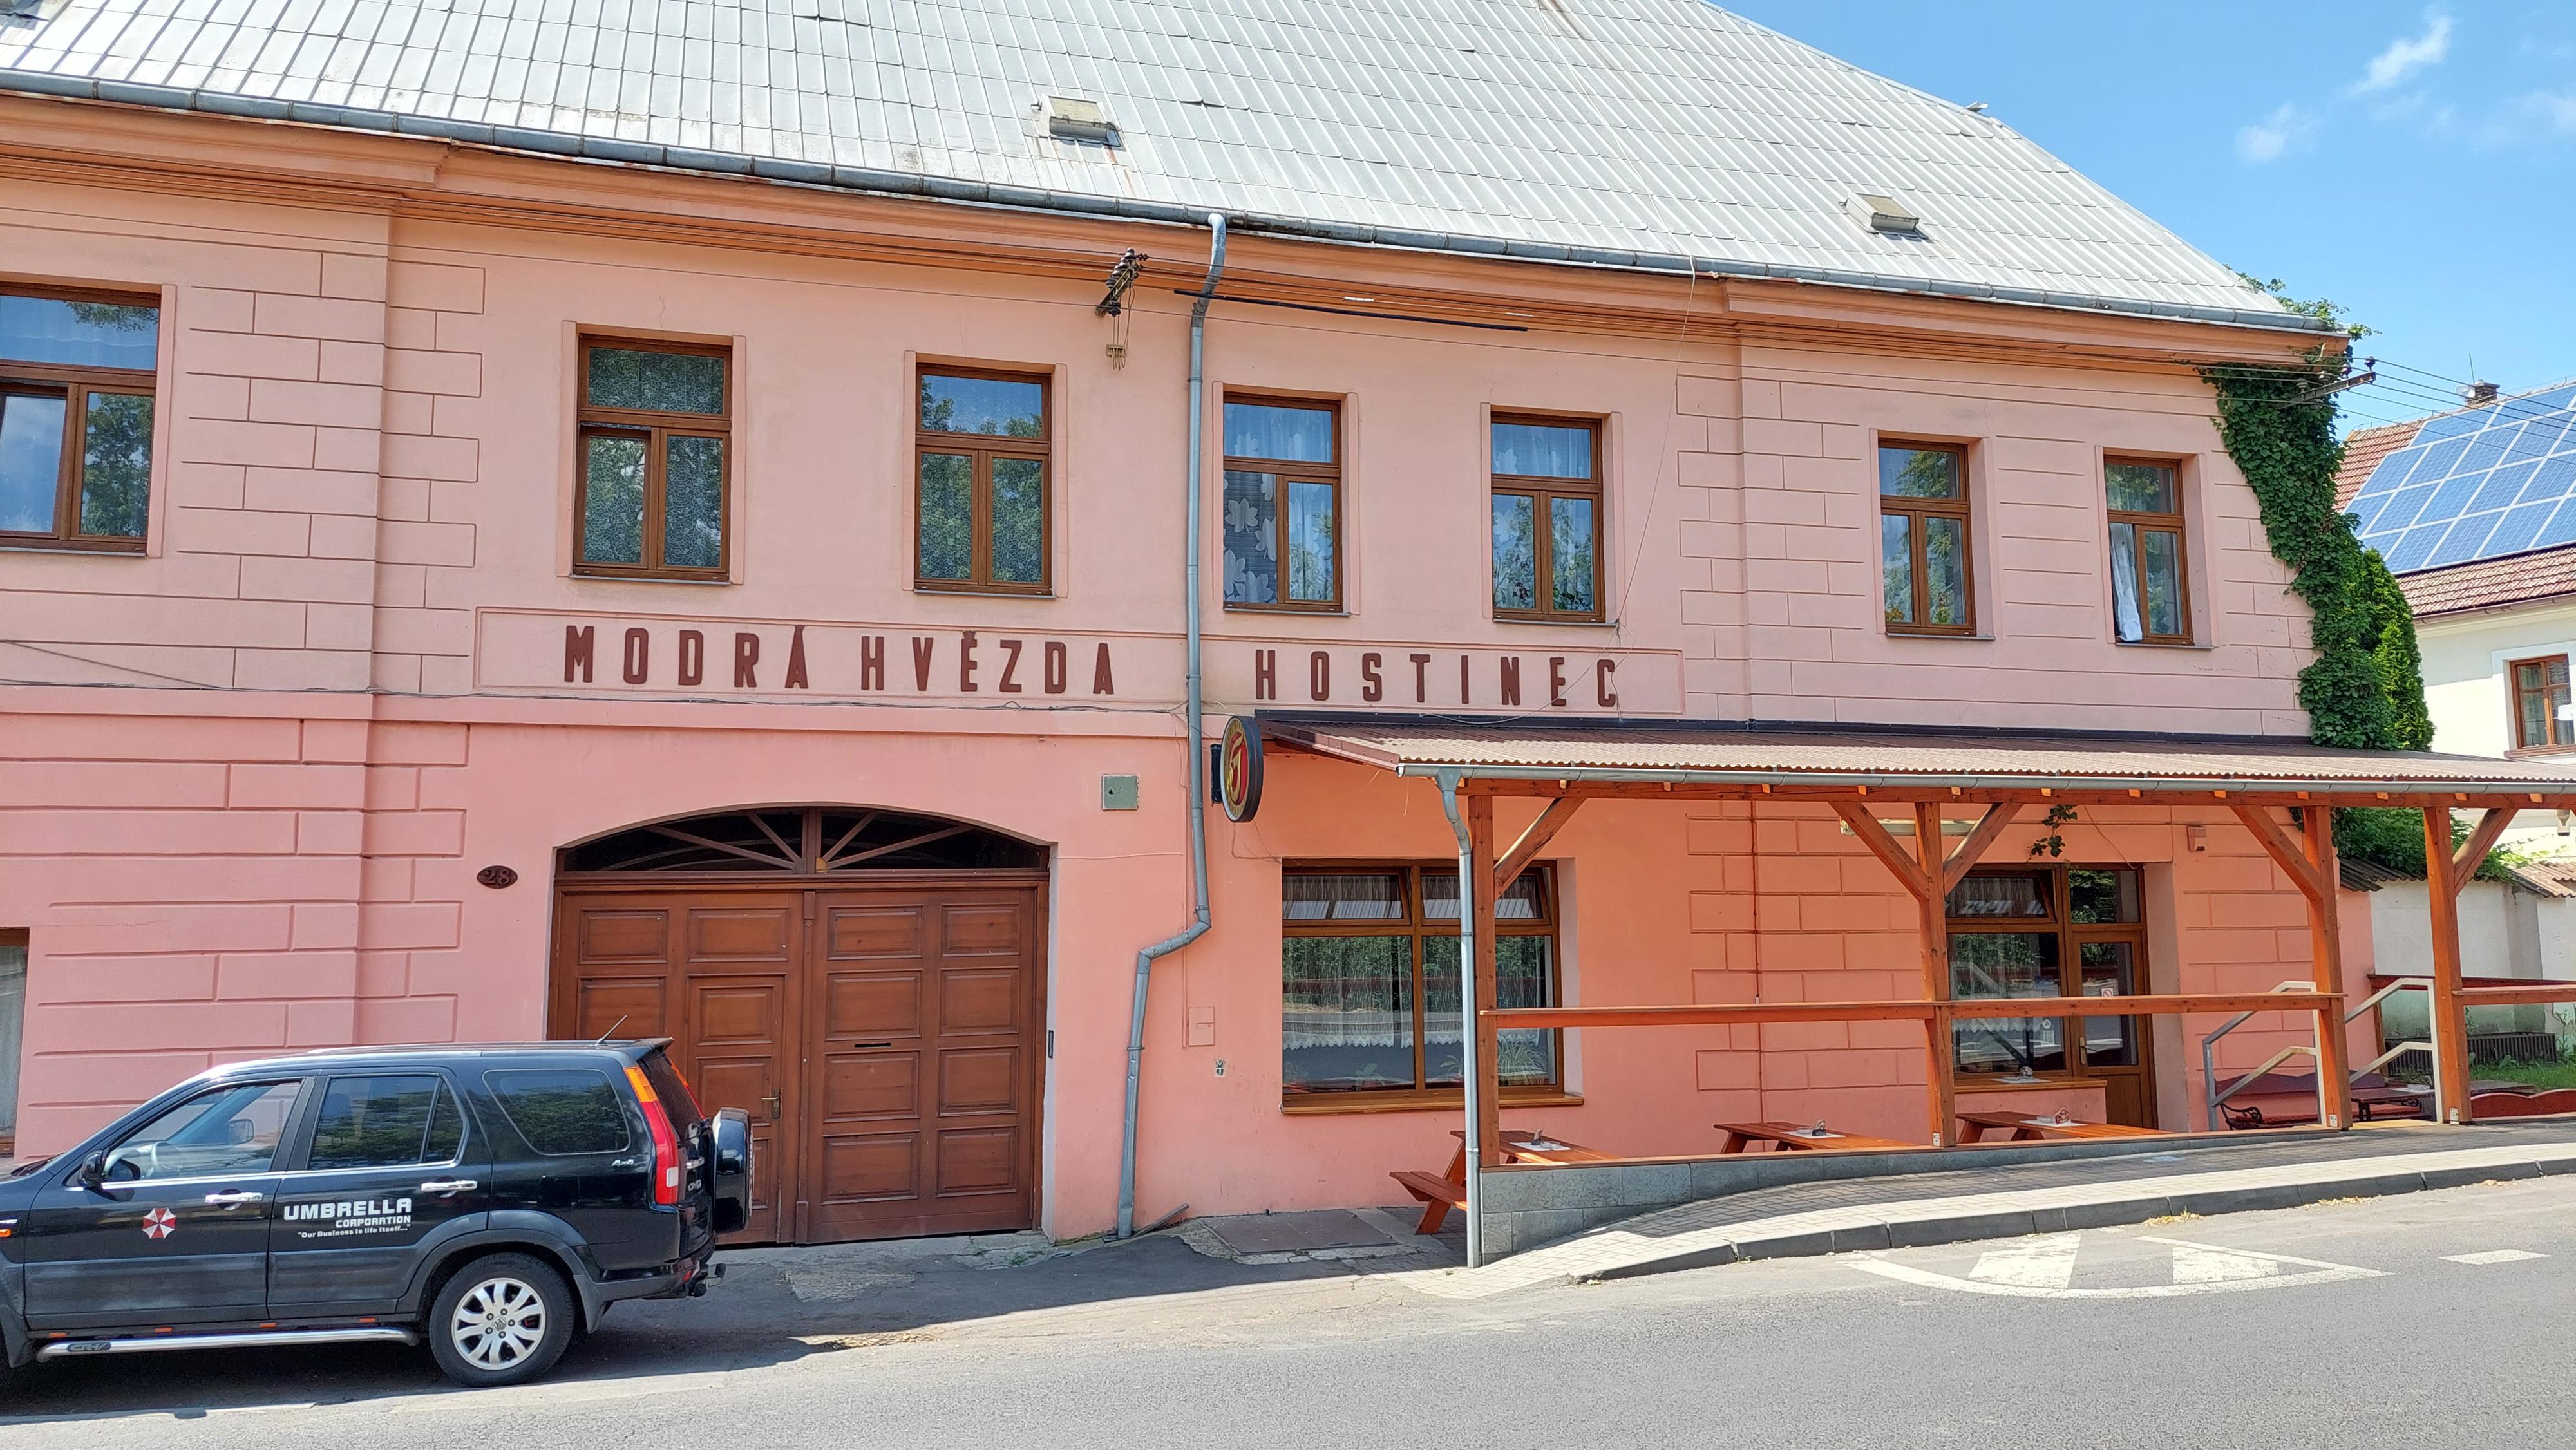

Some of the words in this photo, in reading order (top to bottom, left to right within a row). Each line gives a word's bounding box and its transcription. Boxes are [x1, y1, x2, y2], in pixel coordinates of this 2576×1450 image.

[564, 625, 810, 689] MODRÁ
[860, 630, 1115, 695] HVĚZDA
[1255, 649, 1616, 708] HOSTINEC
[483, 869, 511, 886] 28
[283, 1198, 412, 1221] UMBRELLA
[335, 1215, 412, 1229] CORPORATION
